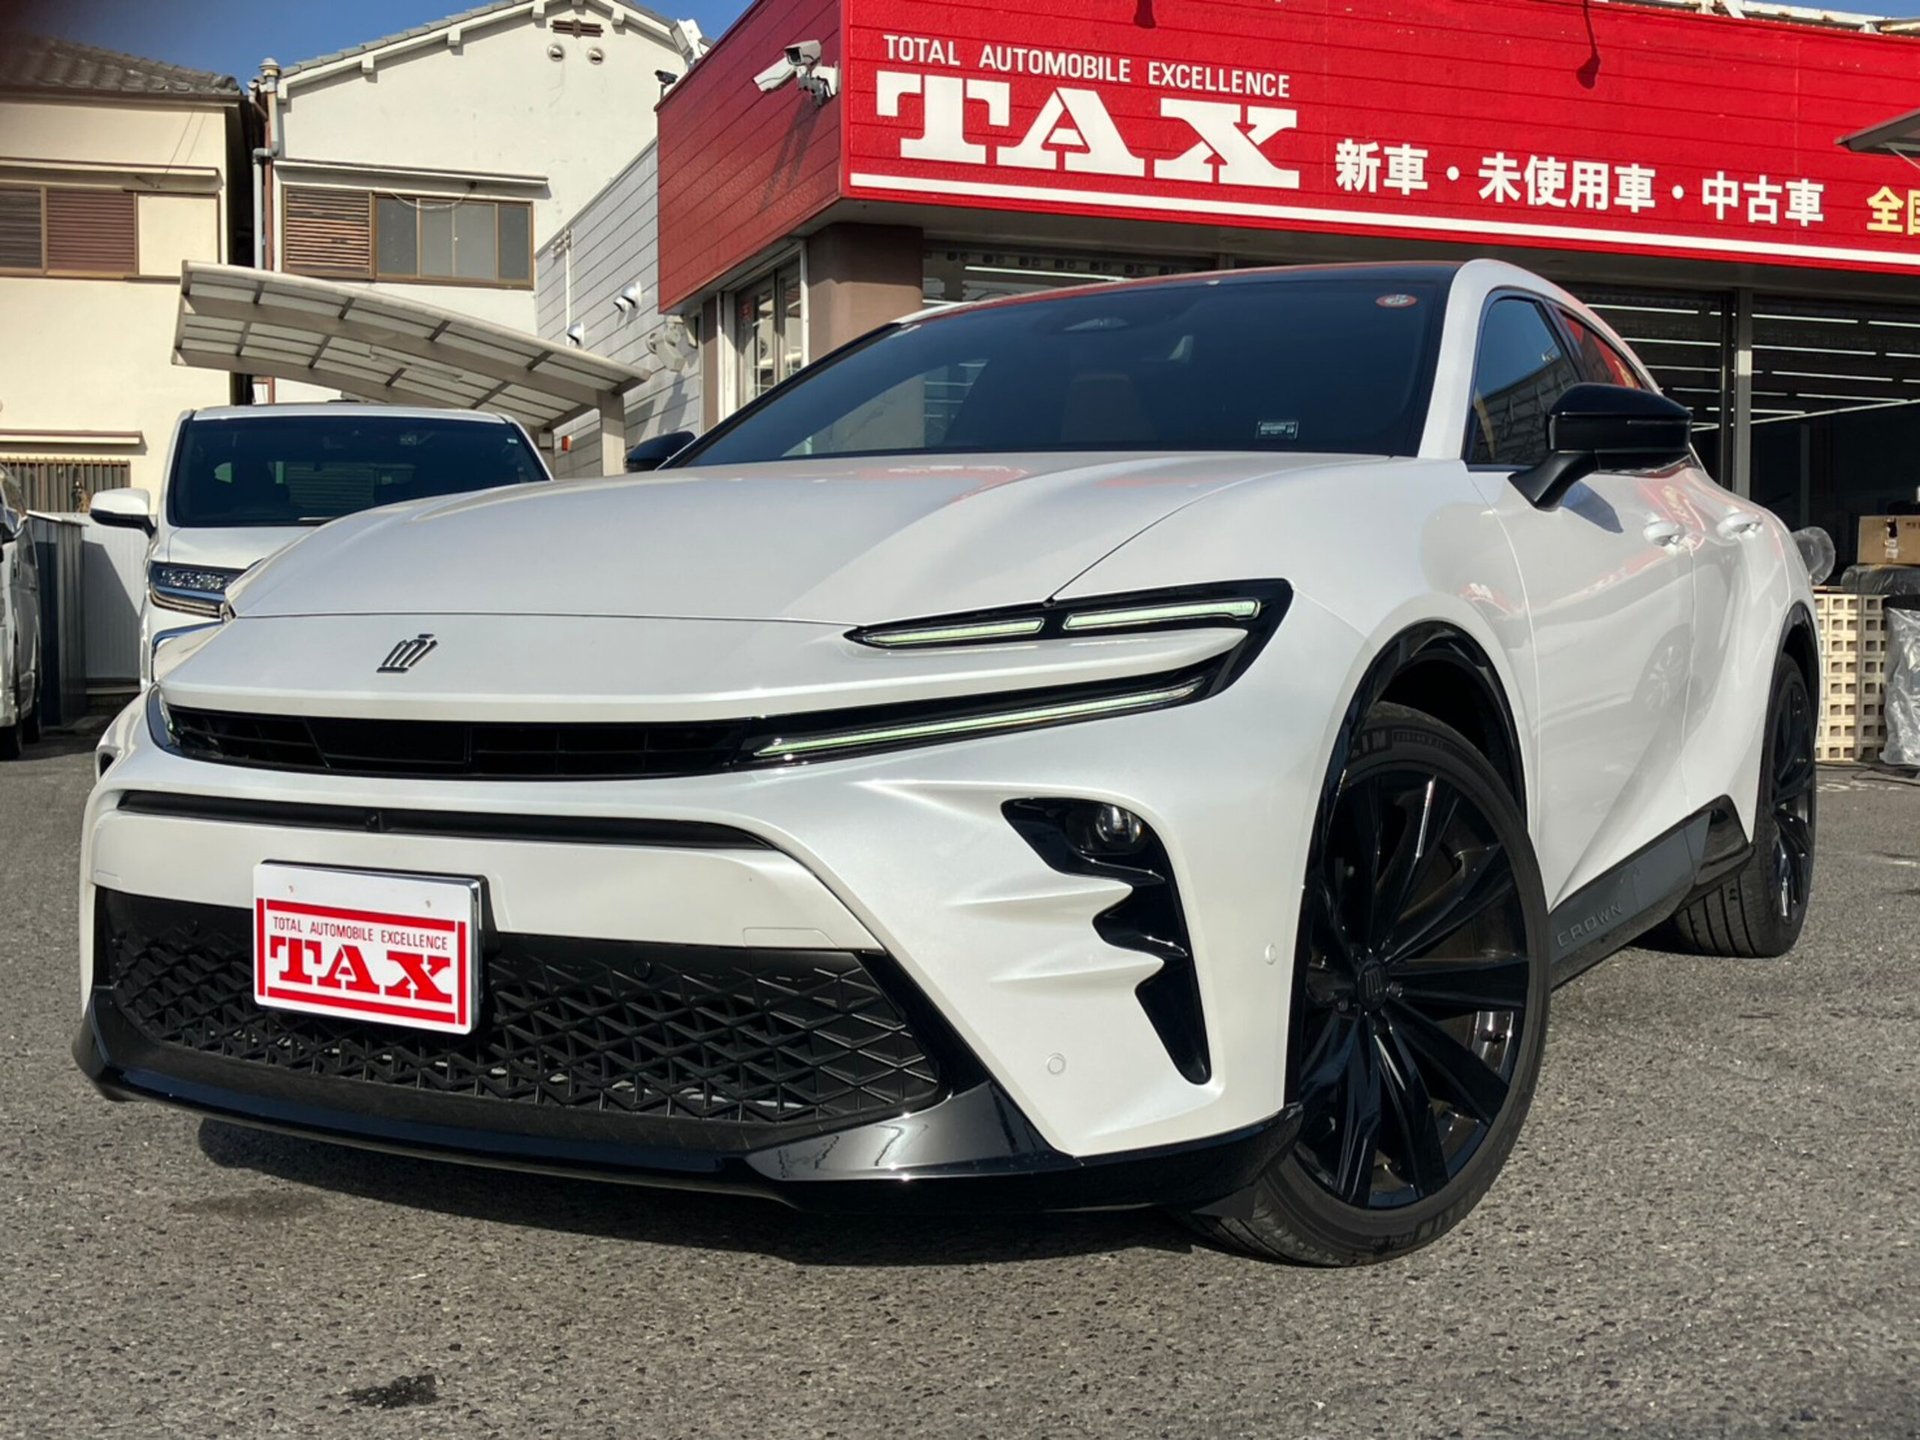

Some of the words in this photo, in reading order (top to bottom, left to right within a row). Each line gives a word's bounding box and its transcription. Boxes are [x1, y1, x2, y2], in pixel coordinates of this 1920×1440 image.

[883, 35, 960, 66] TOTAL
[979, 45, 1131, 83] AUTOMOBILE
[1149, 62, 1290, 98] EXCELLENCE
[876, 71, 1300, 189] TAX
[273, 916, 303, 932] TOTAL
[310, 921, 374, 942] AUTOMOBILE
[381, 930, 448, 950] EXCELLENCE
[1556, 901, 1624, 948] CROWN
[270, 935, 453, 1005] TAX
